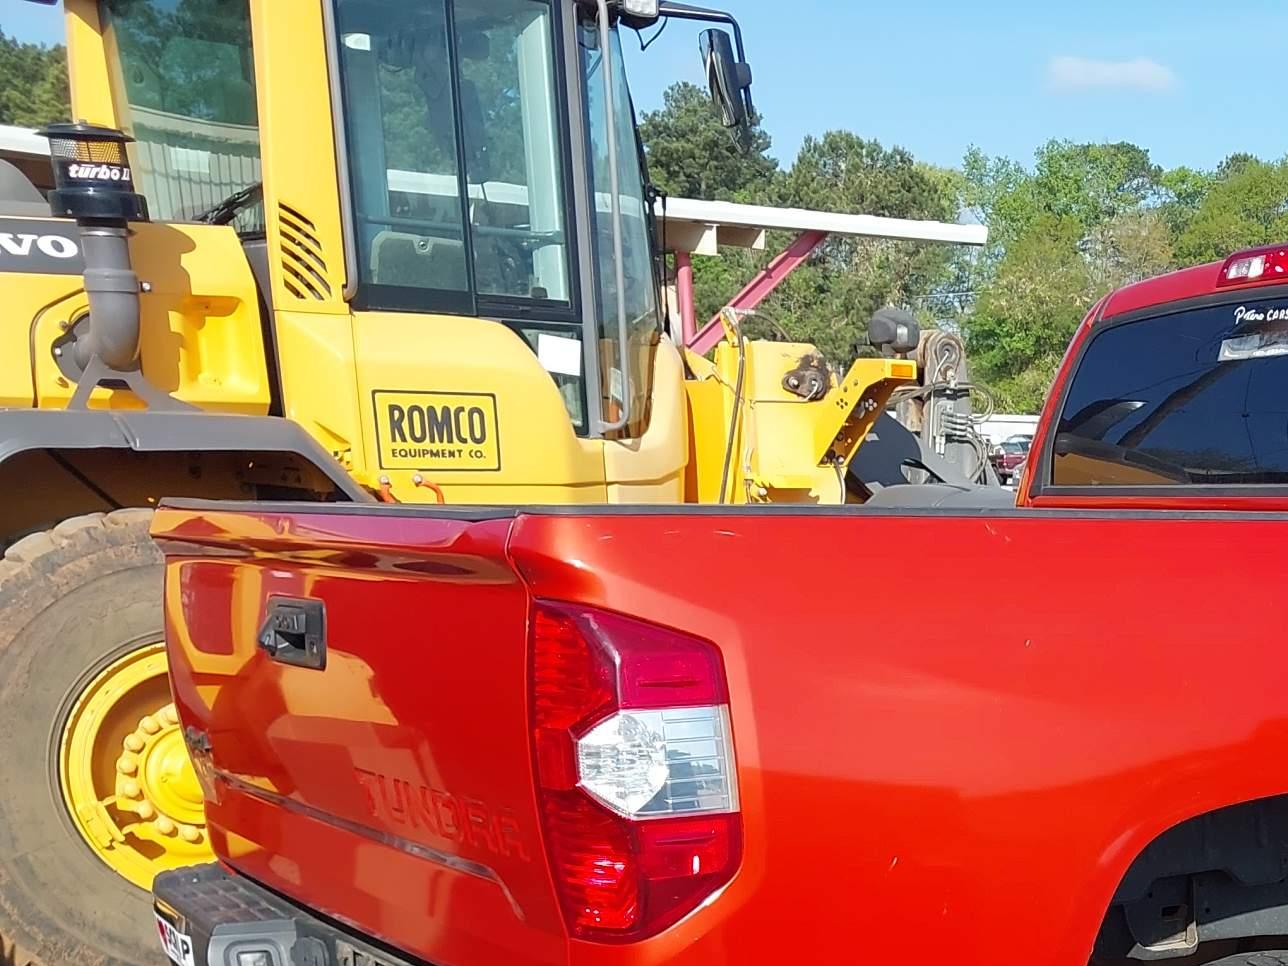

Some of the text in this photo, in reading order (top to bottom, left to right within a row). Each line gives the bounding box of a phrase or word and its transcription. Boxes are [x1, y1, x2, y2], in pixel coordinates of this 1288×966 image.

[68, 164, 120, 180] turbo
[0, 232, 79, 258] VO
[388, 404, 487, 444] ROMCO
[391, 448, 486, 459] EQUIPMENT CO.
[352, 765, 532, 863] TUNDRA
